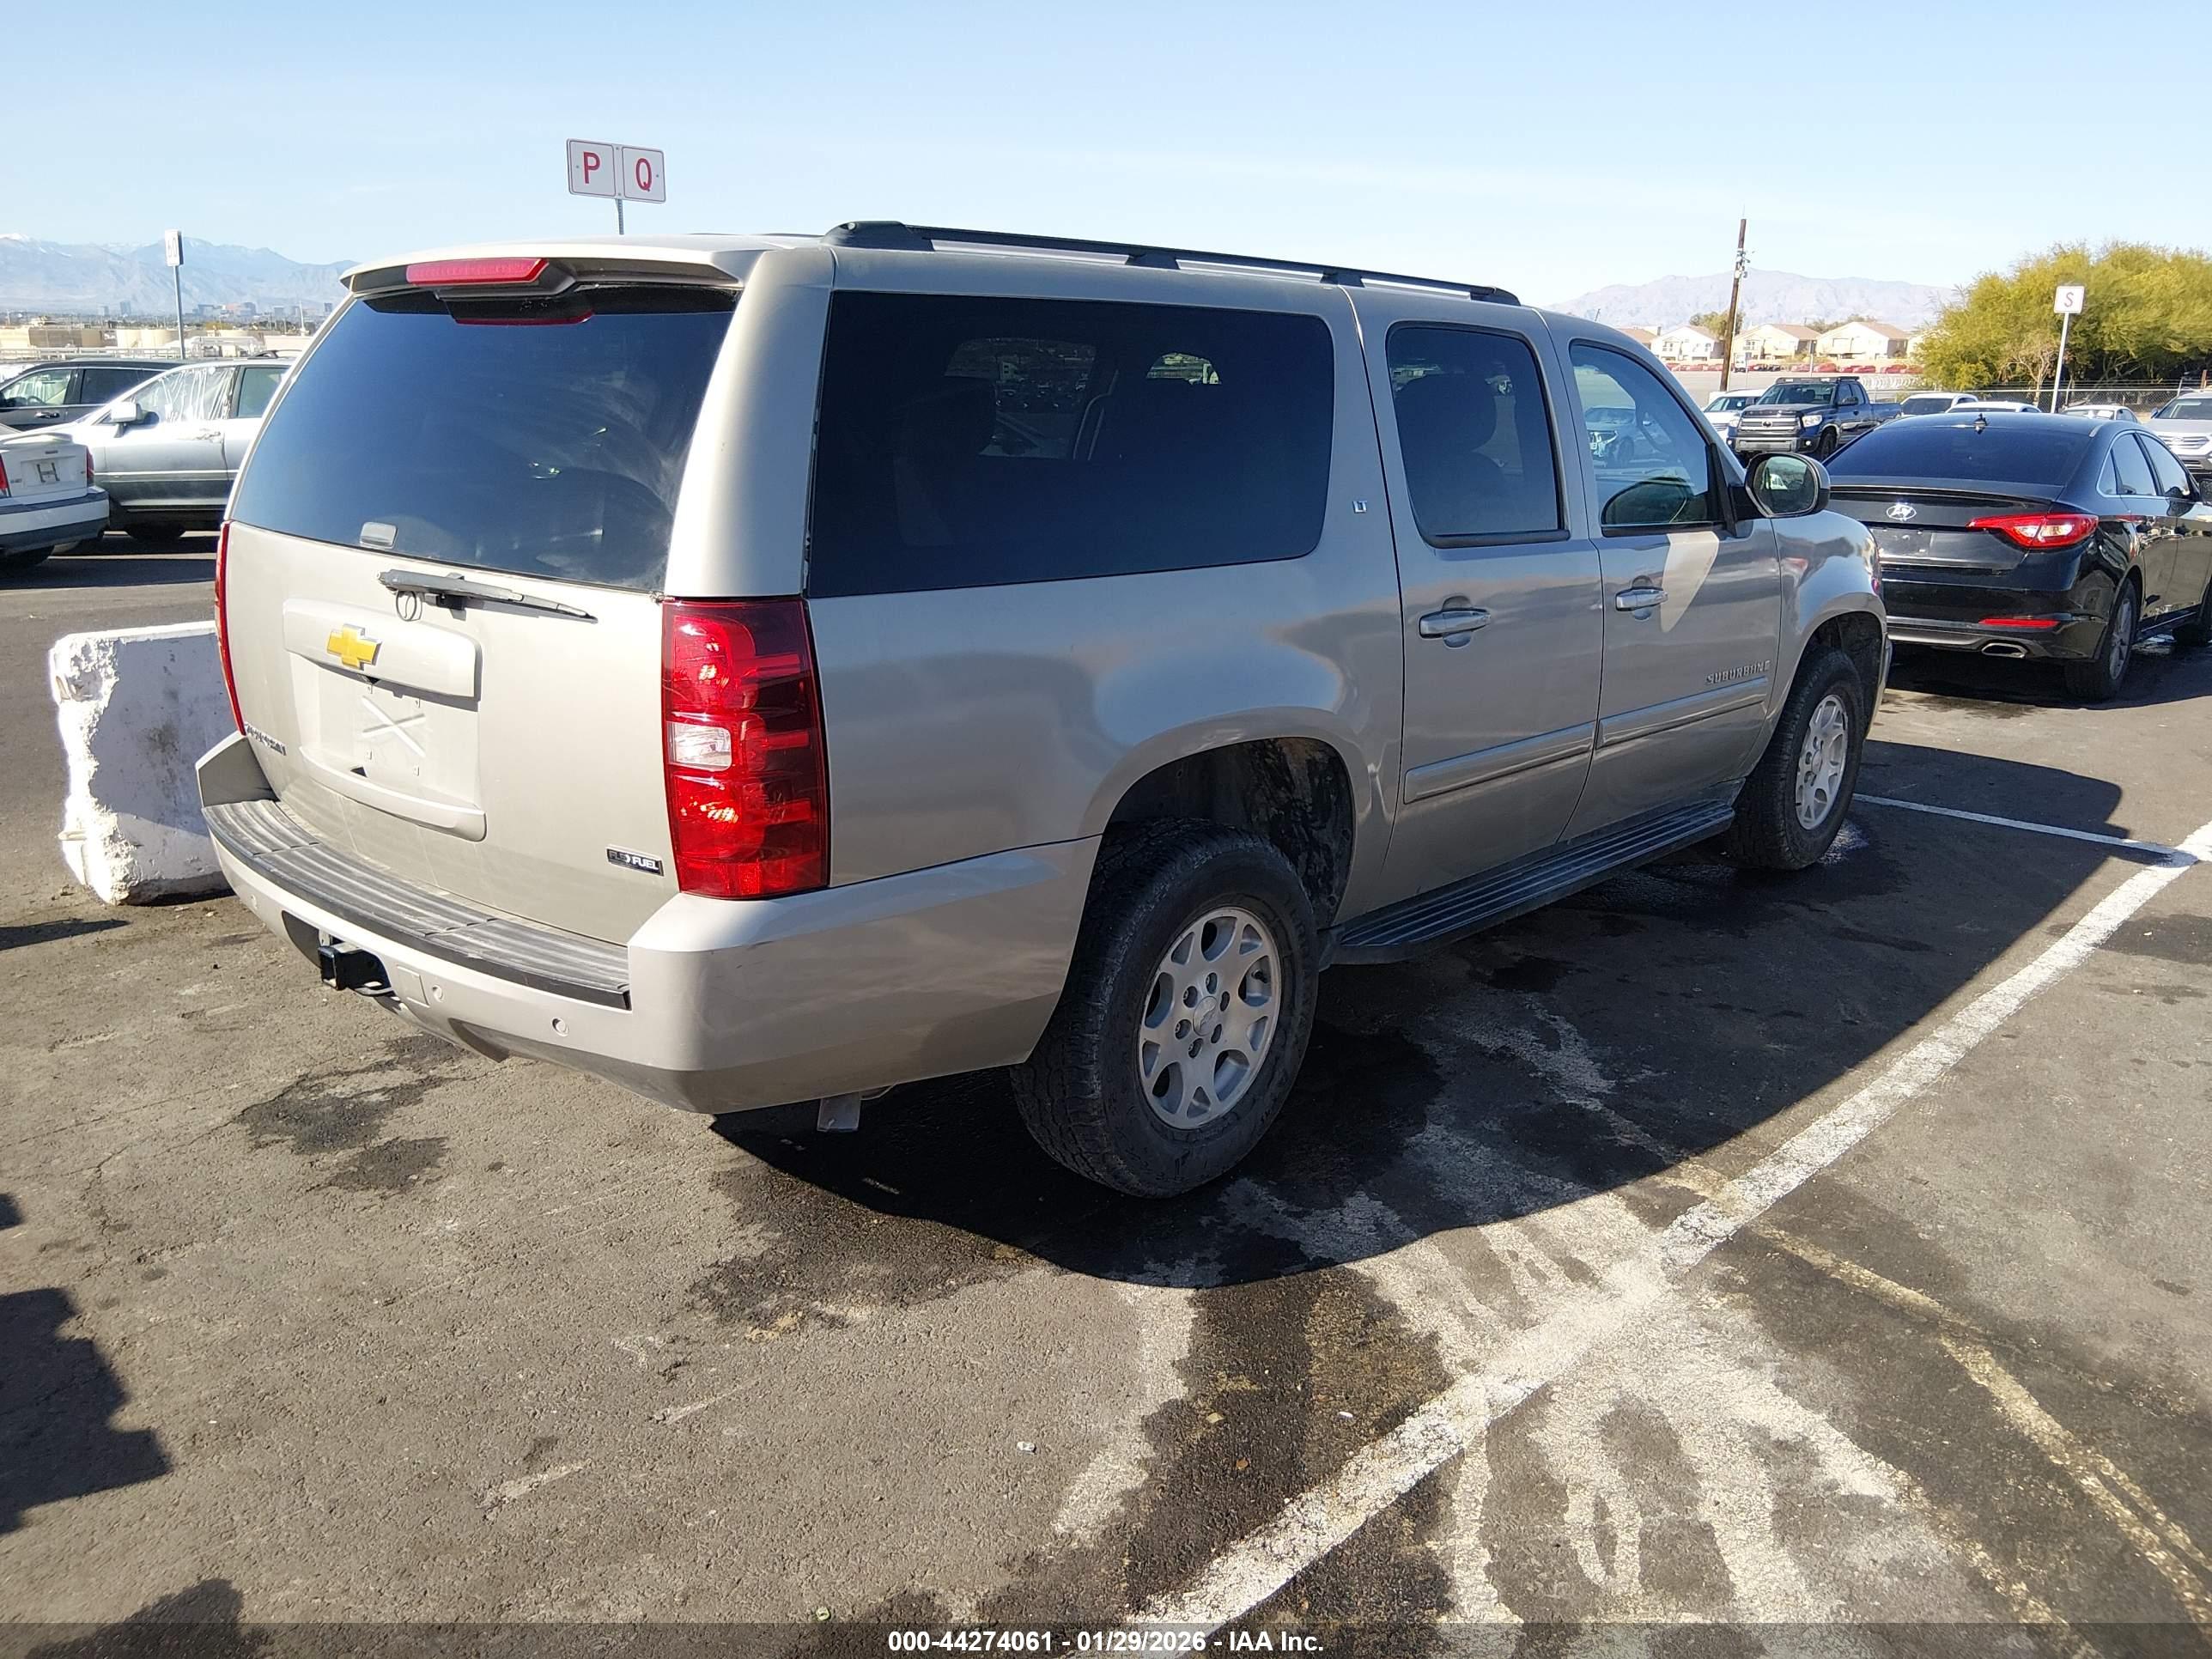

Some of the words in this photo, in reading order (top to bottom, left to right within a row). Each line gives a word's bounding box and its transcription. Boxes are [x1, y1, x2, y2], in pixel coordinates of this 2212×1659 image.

[583, 151, 600, 184] P
[635, 157, 653, 191] Q
[2063, 292, 2075, 307] S
[1352, 500, 1367, 514] LT
